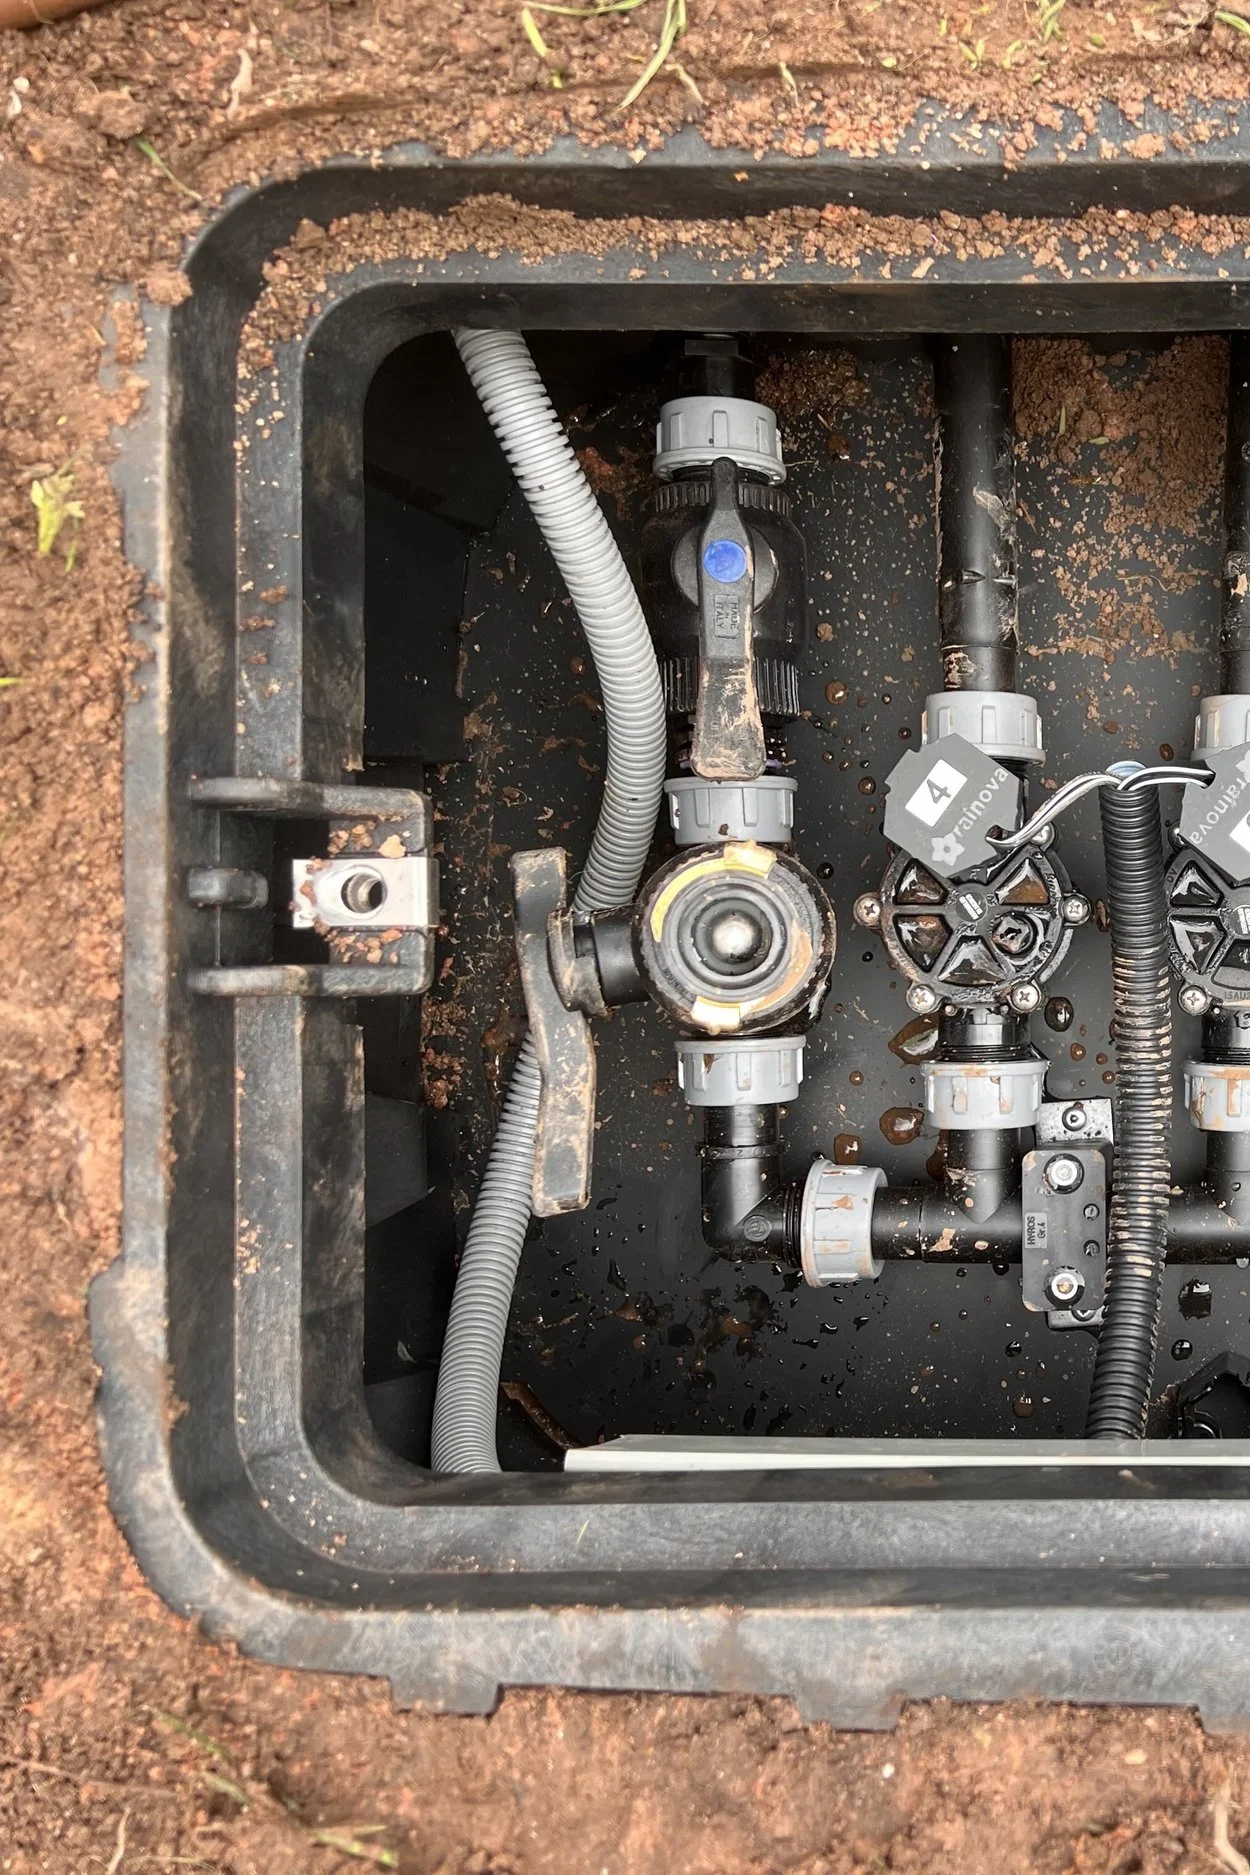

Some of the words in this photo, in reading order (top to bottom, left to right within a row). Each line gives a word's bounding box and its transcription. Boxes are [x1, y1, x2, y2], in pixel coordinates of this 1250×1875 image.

[715, 601, 724, 630] ITALY
[730, 602, 739, 630] MADE
[926, 778, 952, 805] 4
[952, 766, 1009, 839] rainova
[1189, 776, 1248, 846] rainova
[1167, 869, 1178, 884] DV
